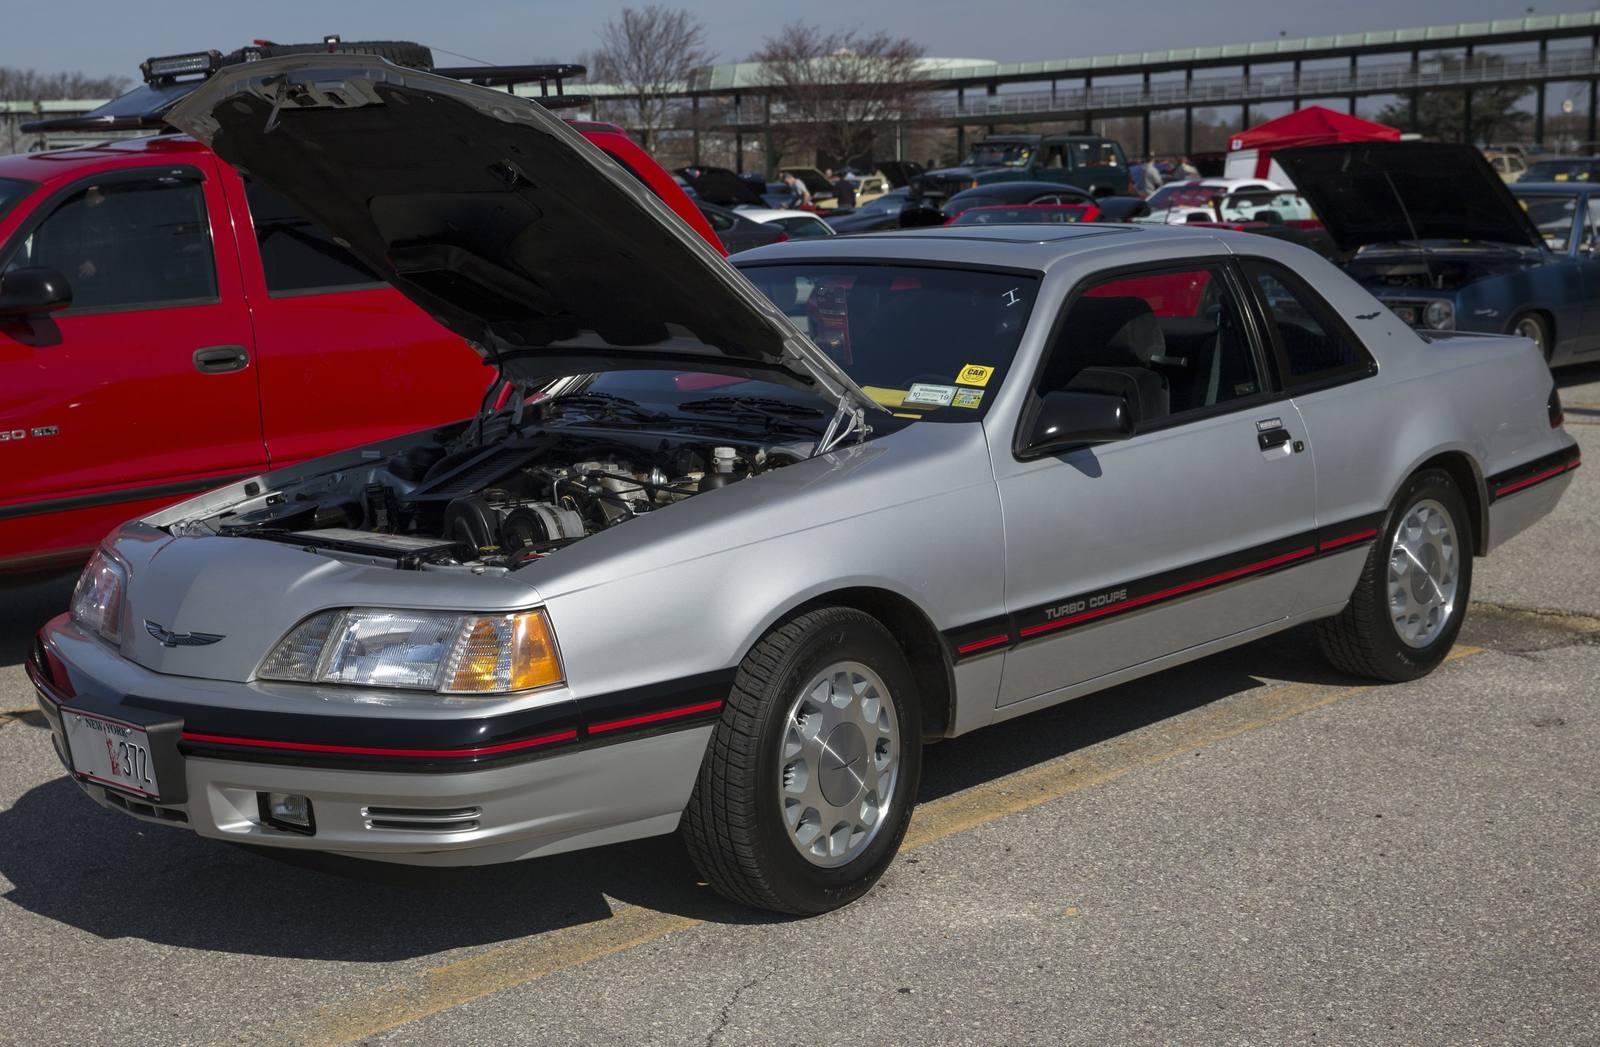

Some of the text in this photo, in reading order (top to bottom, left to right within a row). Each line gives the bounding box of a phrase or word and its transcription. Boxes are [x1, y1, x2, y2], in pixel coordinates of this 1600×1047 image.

[967, 368, 984, 376] CAR
[1045, 589, 1128, 619] TURBO COUPE
[84, 718, 128, 737] NEW YORK
[119, 741, 153, 784] 372
